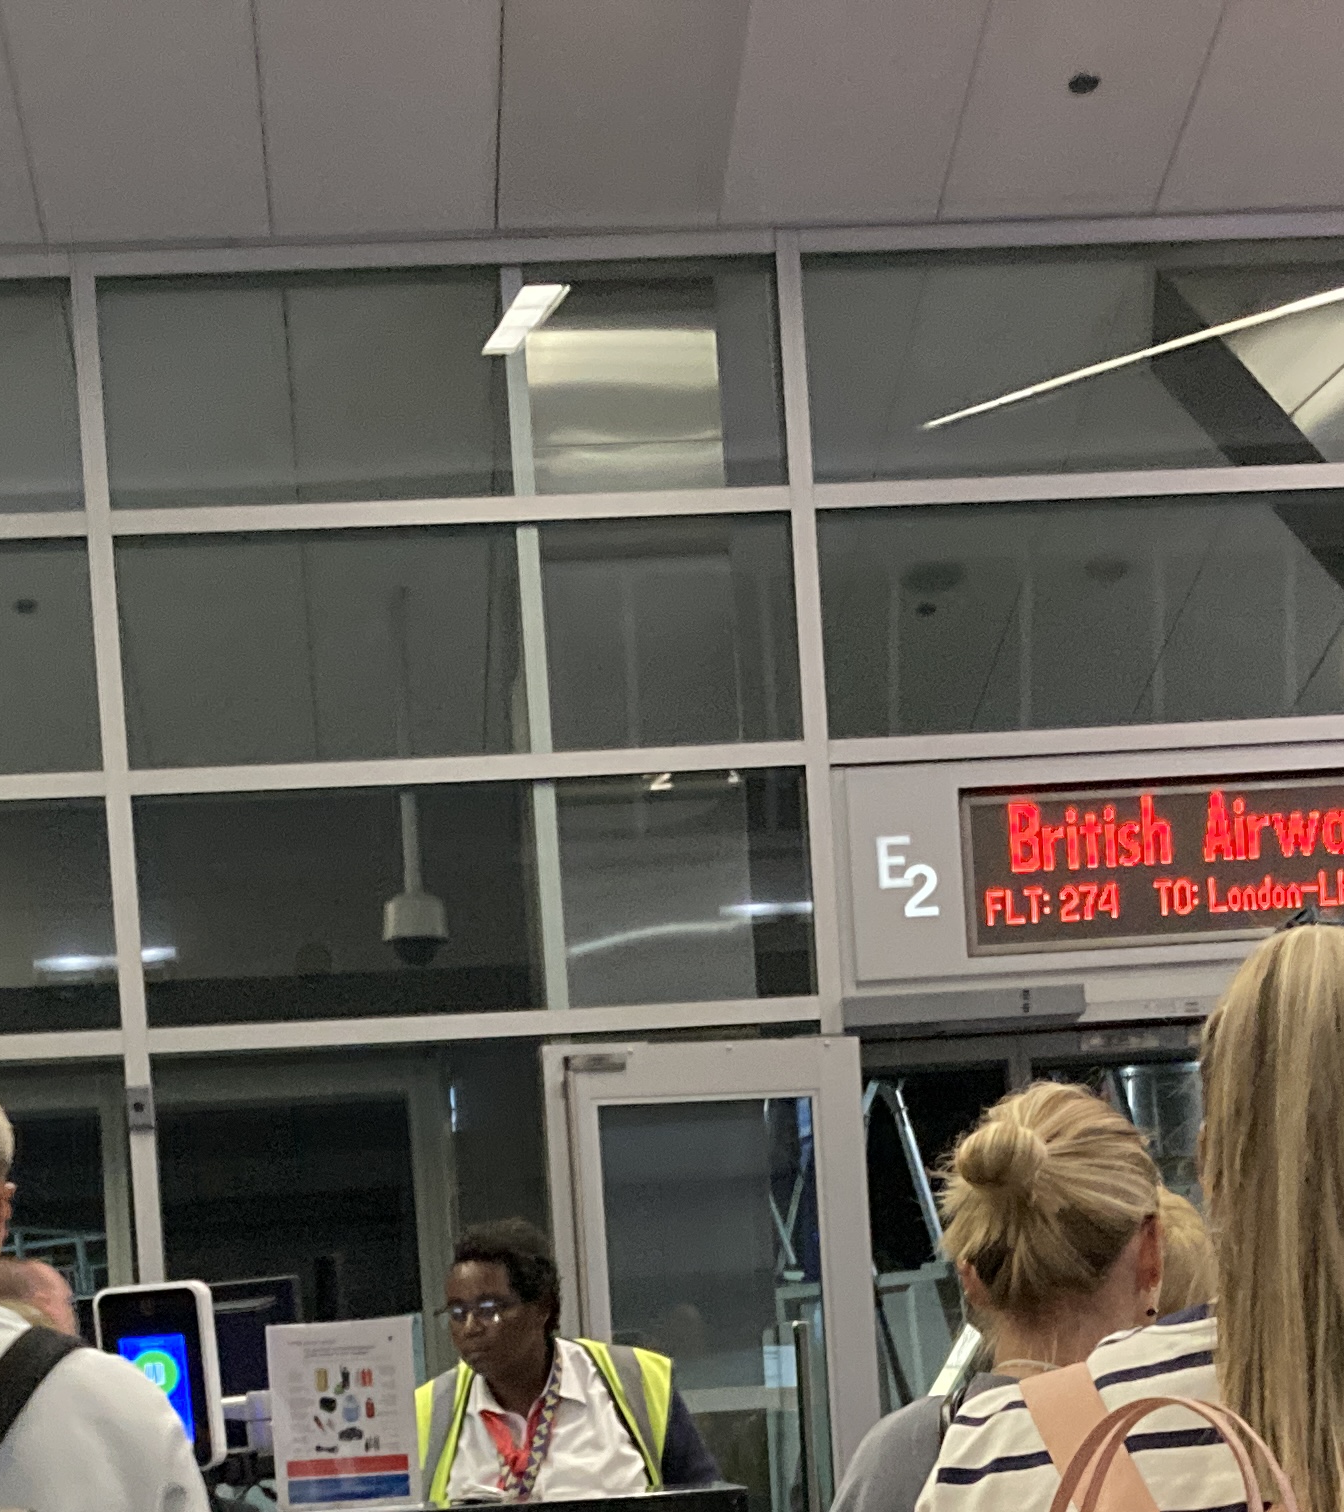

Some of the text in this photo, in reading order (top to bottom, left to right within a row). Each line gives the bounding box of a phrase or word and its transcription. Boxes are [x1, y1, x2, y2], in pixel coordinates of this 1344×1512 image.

[1008, 795, 1173, 873] British
[876, 834, 940, 918] E2
[985, 886, 1051, 927] FLT:
[1059, 881, 1120, 923] 274
[1153, 877, 1199, 917] TO:
